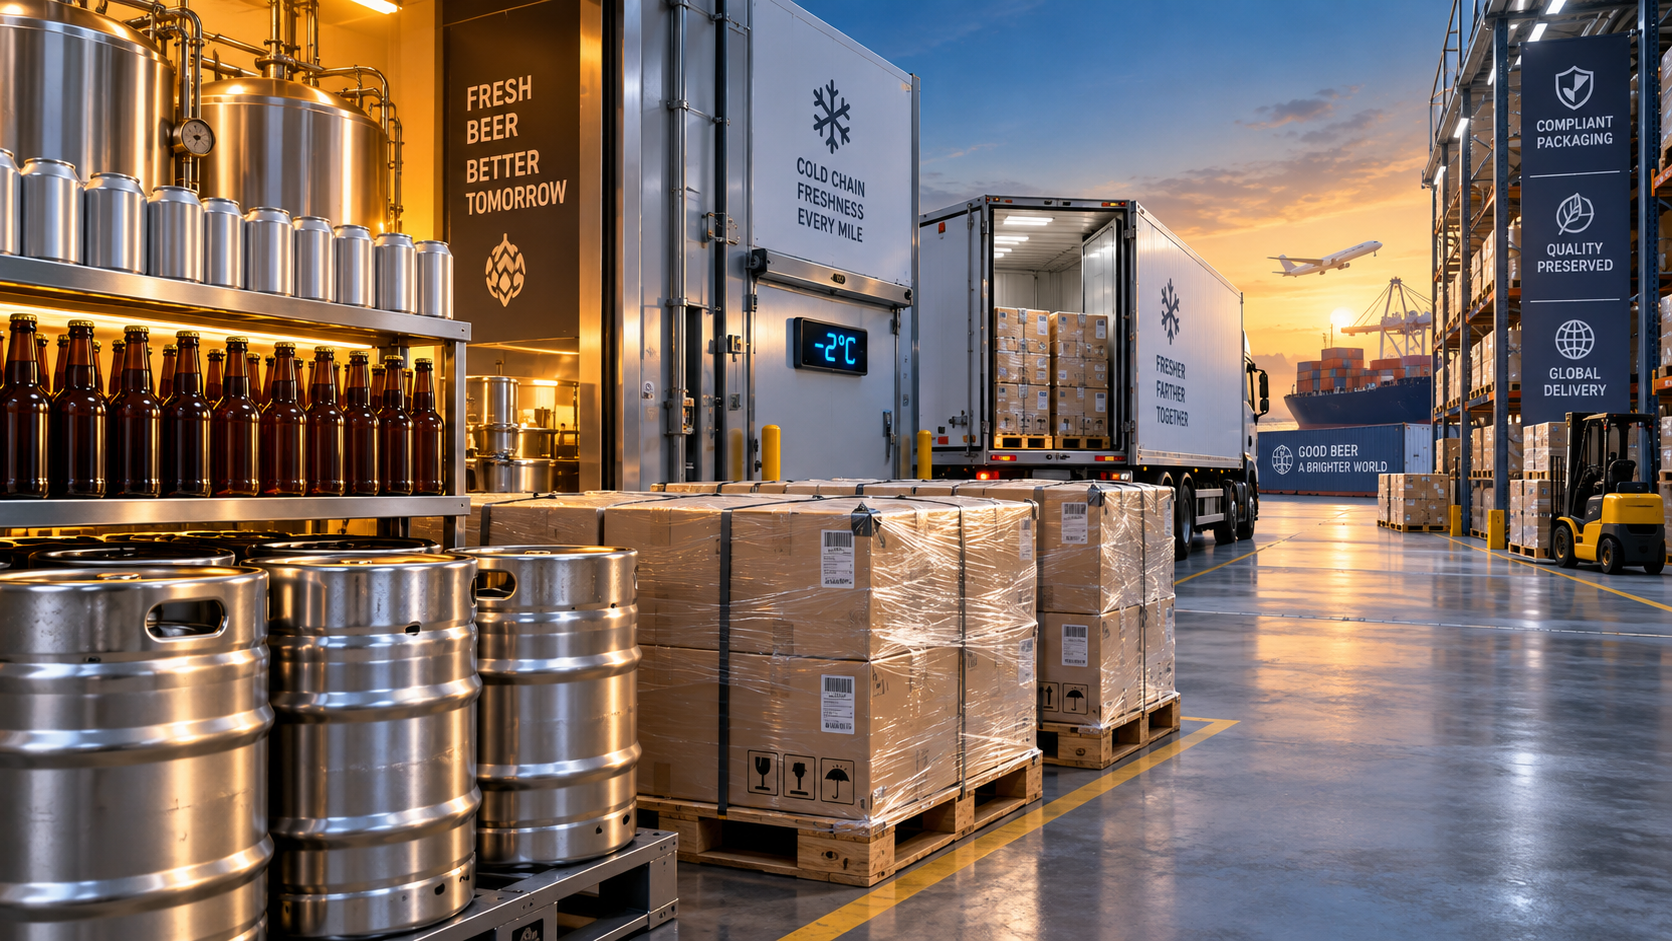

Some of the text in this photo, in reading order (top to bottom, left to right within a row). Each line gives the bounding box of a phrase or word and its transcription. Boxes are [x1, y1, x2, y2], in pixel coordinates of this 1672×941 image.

[466, 74, 532, 112] FRESH
[466, 112, 519, 145] BEER
[1536, 115, 1614, 133] COMPLIANT
[1536, 132, 1613, 149] PACKAGING
[466, 149, 540, 184] BETTER
[796, 156, 865, 198] COLD CHAIN
[465, 179, 567, 216] TOMORROW
[797, 181, 864, 220] FRESHNESS
[798, 207, 863, 243] EVERY MILE
[1546, 242, 1603, 258] QUALITY
[1537, 258, 1614, 273] PRESERVED
[814, 332, 856, 365] -2°C
[1156, 354, 1186, 380] FRESHER
[1549, 367, 1601, 380] GLOBAL
[1156, 380, 1186, 403] FARTHER
[1543, 384, 1607, 397] DELIVERY
[1156, 405, 1189, 427] TOGETHER
[1298, 444, 1358, 458] GOOD BEER
[1298, 460, 1388, 473] A BRIGHTER WORLD
